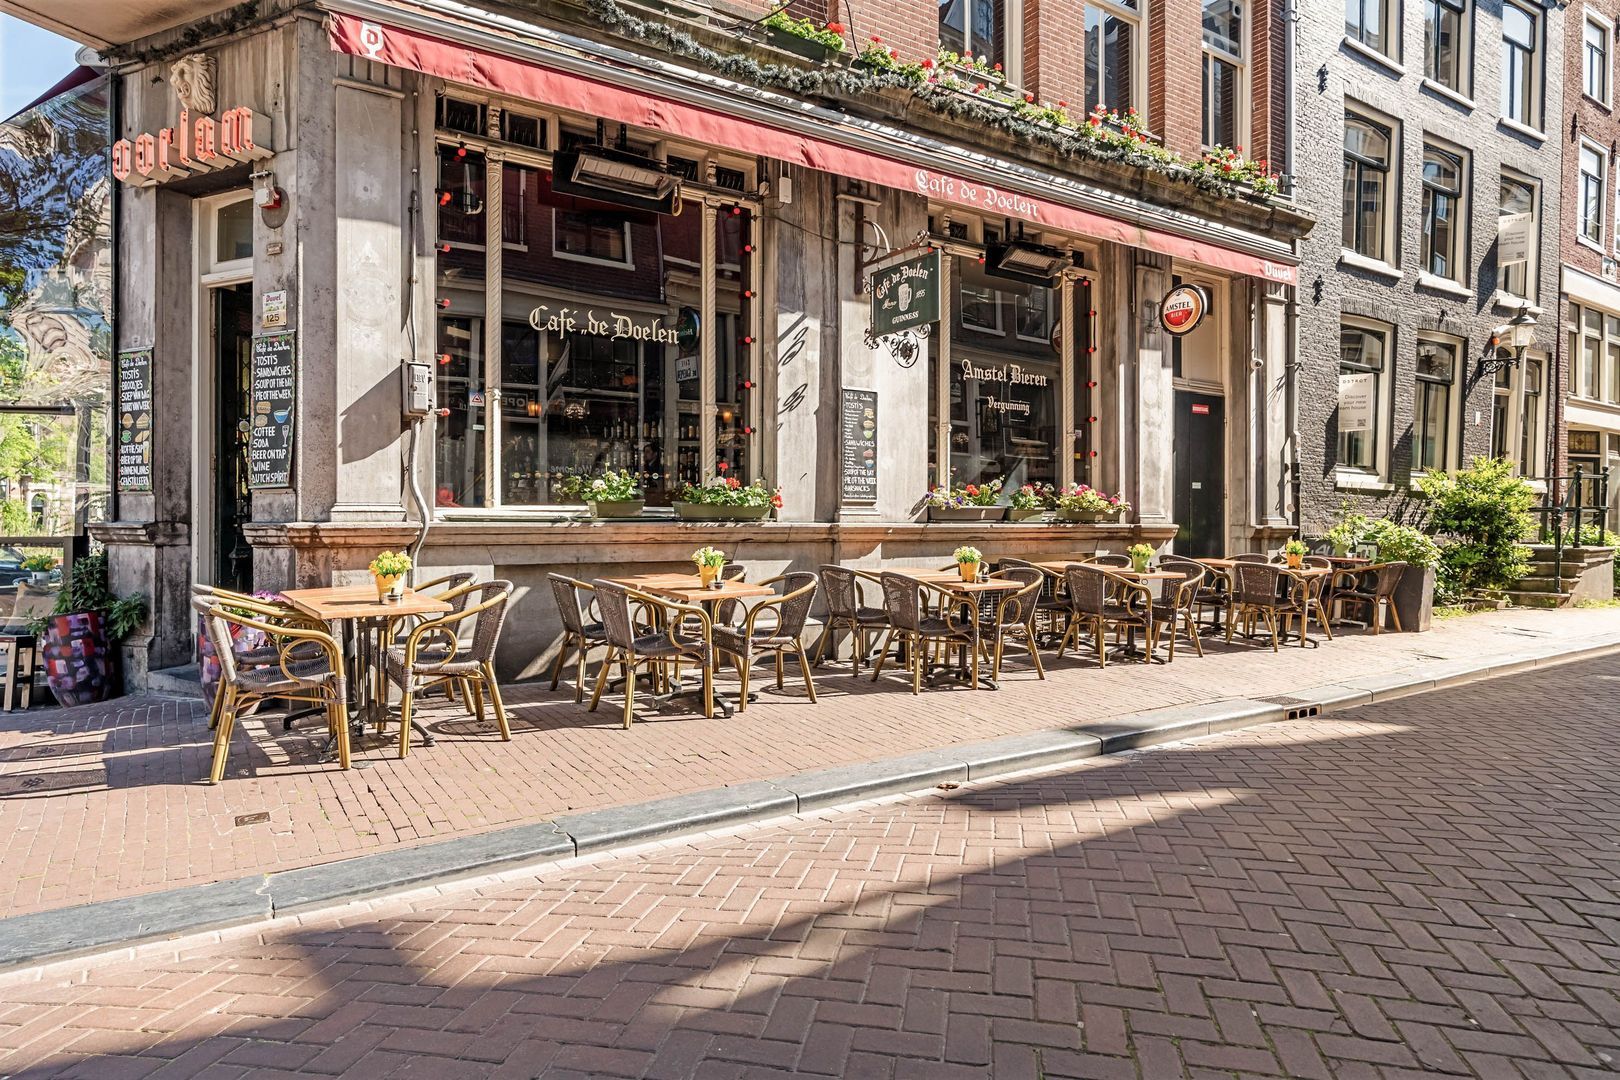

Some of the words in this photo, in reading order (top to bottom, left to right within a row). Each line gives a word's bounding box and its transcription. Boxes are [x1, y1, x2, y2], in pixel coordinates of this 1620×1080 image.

[914, 169, 955, 197] Café
[960, 181, 977, 200] de
[982, 185, 1040, 217] Doelen
[1264, 260, 1292, 281] Duvel
[876, 276, 891, 299] Café
[265, 294, 282, 303] Duvel
[1166, 301, 1191, 312] AMSTEL
[266, 313, 280, 324] 125
[891, 310, 920, 325] GUINNESS
[1170, 311, 1183, 319] BIER
[528, 305, 578, 340] Café
[610, 312, 680, 345] Doelen
[961, 358, 1008, 382] Amstel
[1009, 363, 1048, 387] Bieren
[987, 395, 1031, 416] Vergunning
[252, 449, 267, 460] BEER
[267, 449, 276, 459] ON
[276, 449, 287, 459] TAP
